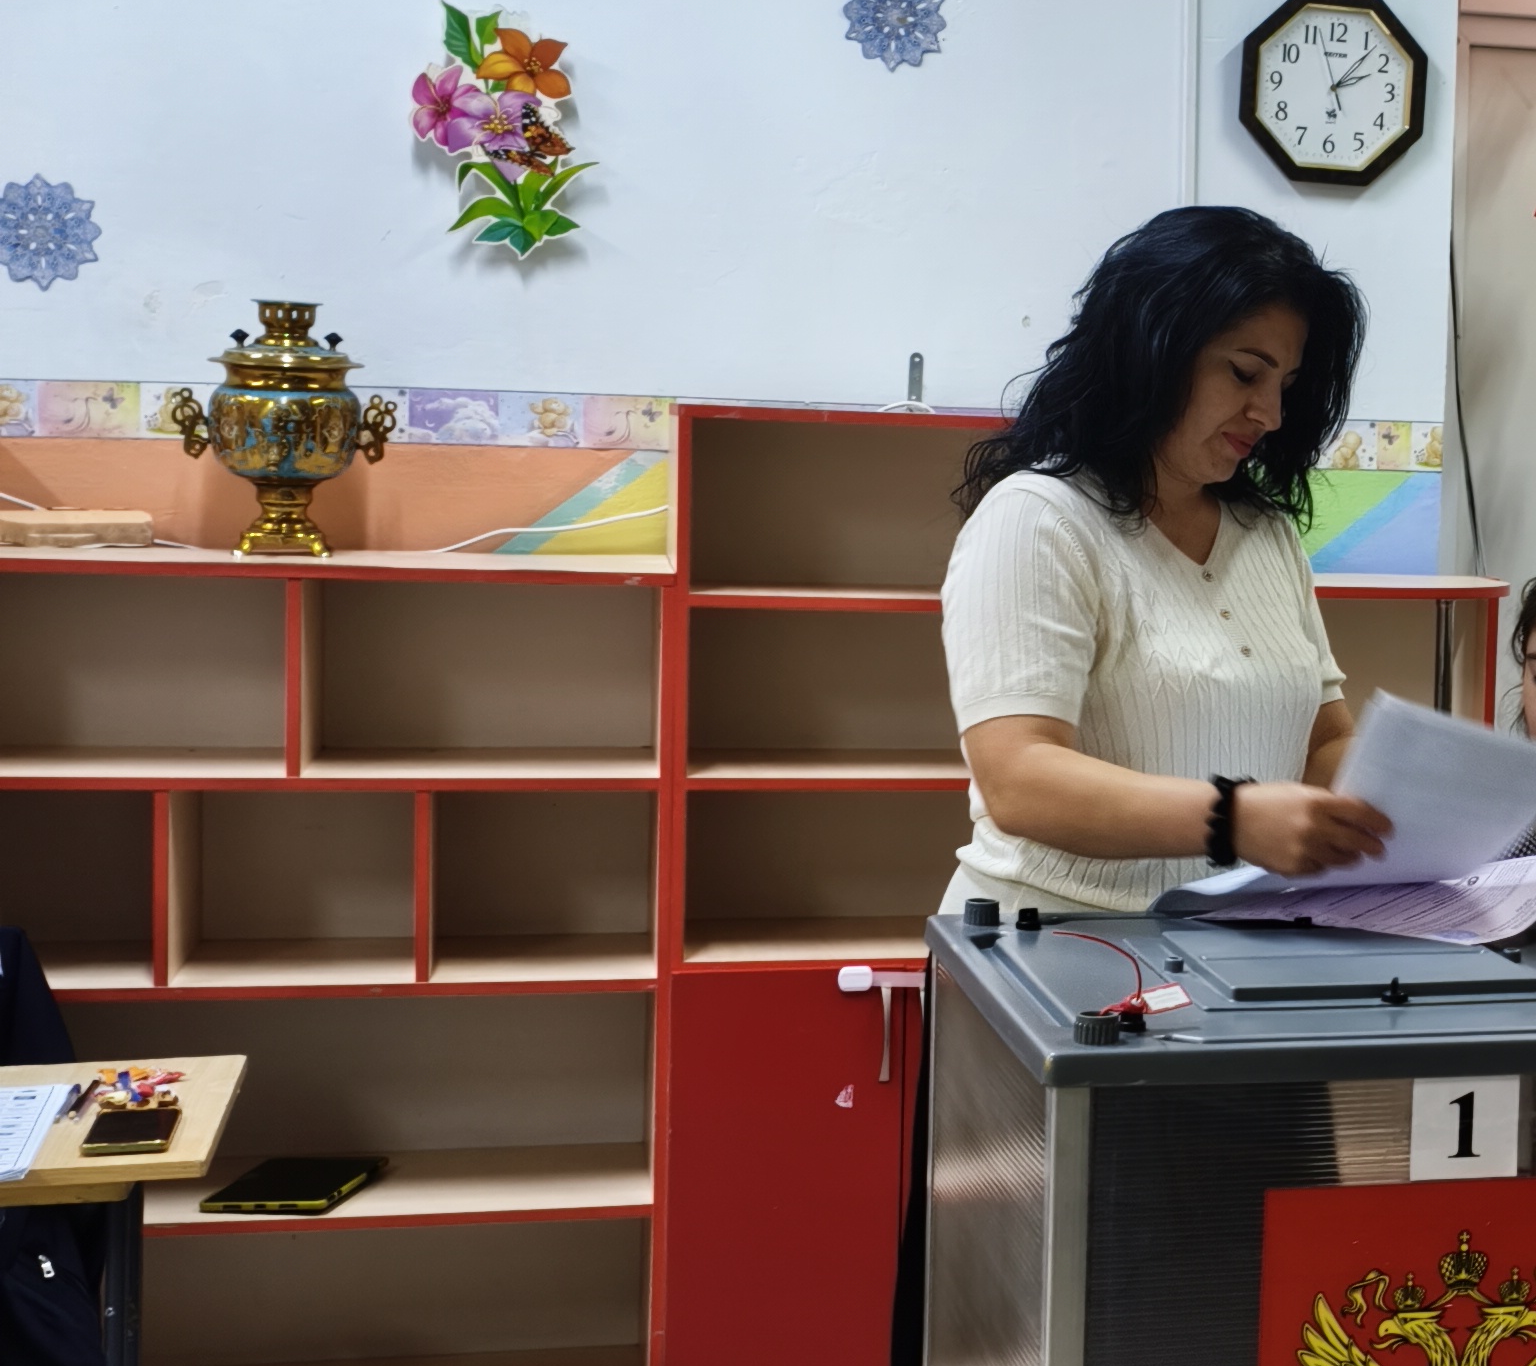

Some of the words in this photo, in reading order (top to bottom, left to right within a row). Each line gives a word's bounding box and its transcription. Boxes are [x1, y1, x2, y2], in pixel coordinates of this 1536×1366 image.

[1304, 24, 1318, 44] 11
[1329, 22, 1348, 43] 12
[1363, 31, 1370, 51] 1
[1282, 43, 1300, 64] 10
[1377, 53, 1389, 73] 2
[1270, 70, 1283, 91] 9
[1384, 83, 1395, 103] 3
[1274, 101, 1288, 121] 8
[1373, 112, 1385, 131] 4
[1295, 126, 1308, 146] 7
[1322, 133, 1335, 154] 6
[1352, 132, 1365, 152] 5
[1448, 1091, 1481, 1159] 1
